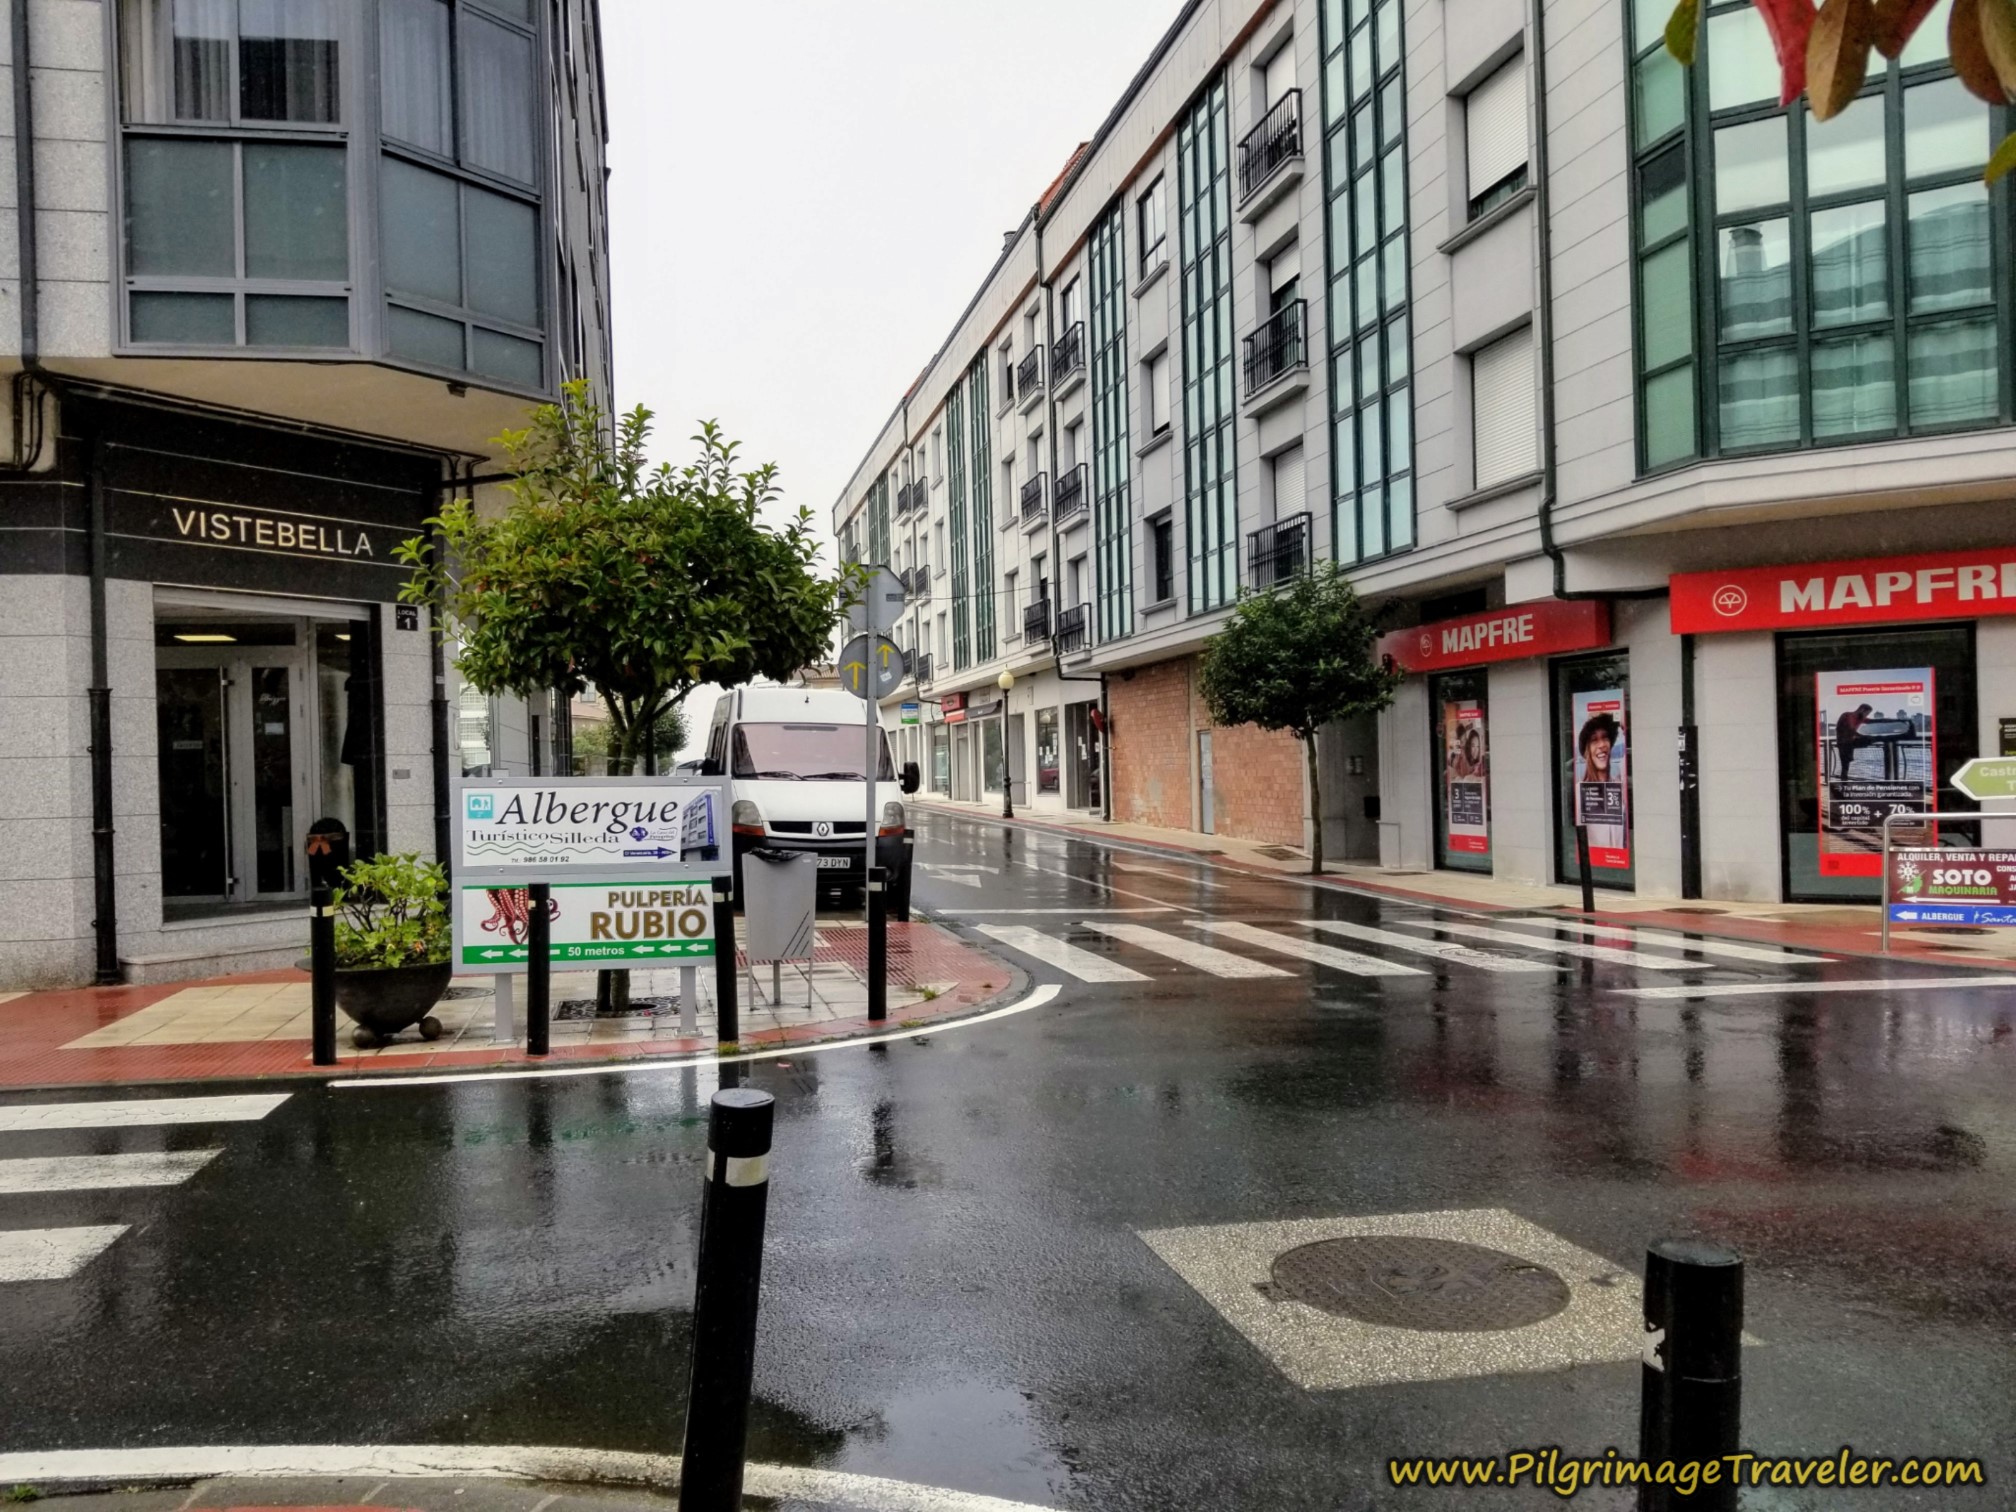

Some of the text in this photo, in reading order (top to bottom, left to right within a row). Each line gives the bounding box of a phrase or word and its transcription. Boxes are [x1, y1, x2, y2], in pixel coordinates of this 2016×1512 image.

[172, 508, 373, 556] VISTEBELLA
[404, 617, 411, 630] 1
[1442, 614, 1533, 654] MAPFRE
[495, 791, 678, 834] Albergue
[1839, 804, 1870, 815] 100%
[1888, 804, 1915, 814] 70%
[831, 859, 849, 867] DYN
[1897, 852, 1944, 862] ALQUILER,
[1945, 853, 1977, 861] VENTA
[1978, 853, 1985, 861] Y
[1932, 869, 1992, 885] SOTO
[608, 884, 708, 908] PULPERÍA
[1928, 886, 1998, 895] MAQUINARIA
[1921, 912, 1965, 921] ALBERGUE
[590, 909, 707, 940] RUBIO
[568, 946, 625, 956] 50 metros
